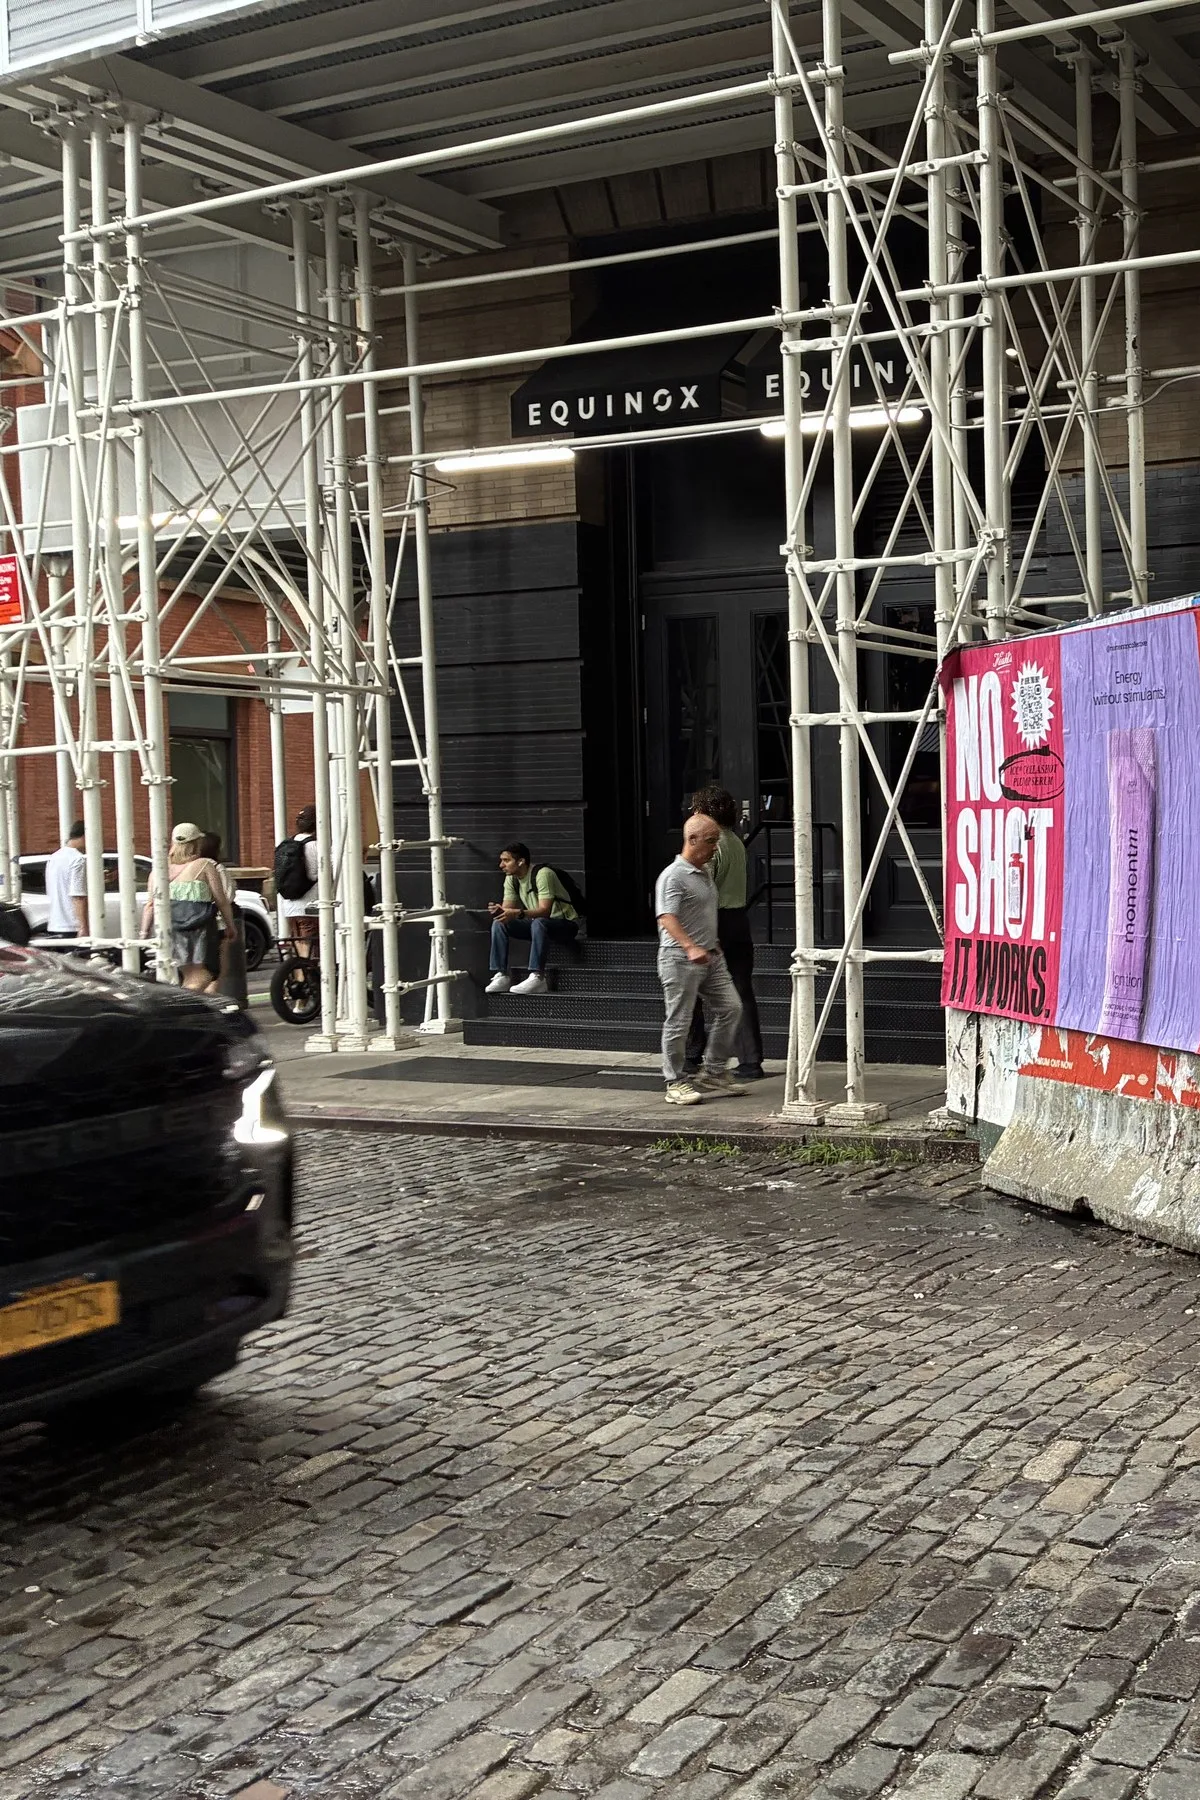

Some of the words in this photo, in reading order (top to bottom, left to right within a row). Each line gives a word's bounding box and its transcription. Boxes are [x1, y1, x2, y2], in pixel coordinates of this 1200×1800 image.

[528, 384, 700, 426] EQUINOX
[766, 360, 912, 399] EQUIN
[1115, 670, 1143, 686] Energy
[953, 671, 1005, 802] NO
[955, 807, 1056, 942] SHOT.
[1125, 828, 1138, 943] momentm
[950, 938, 973, 1003] IT
[975, 940, 1050, 1019] WORKS.
[1112, 971, 1142, 990] Igntion
